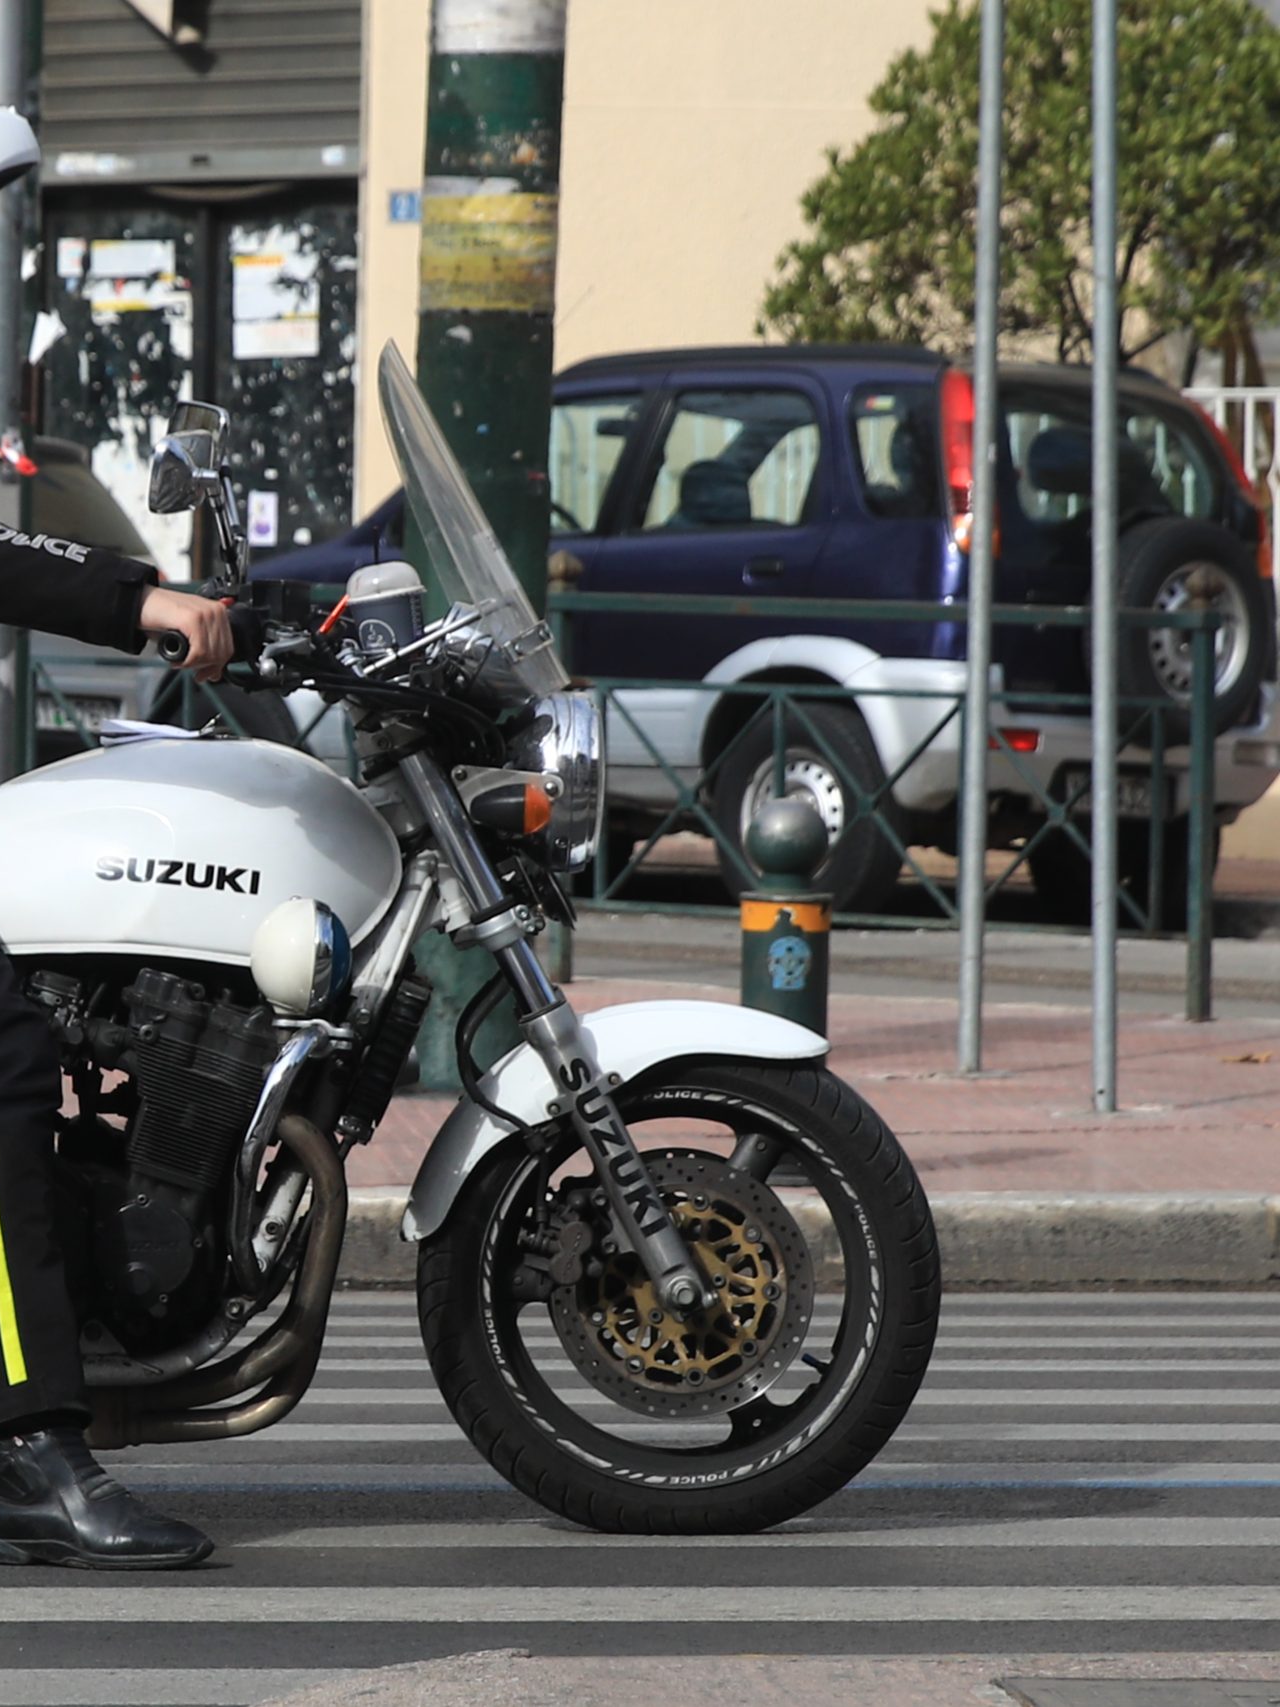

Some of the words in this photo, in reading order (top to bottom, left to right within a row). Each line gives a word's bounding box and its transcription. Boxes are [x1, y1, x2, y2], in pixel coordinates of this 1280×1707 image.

[95, 855, 261, 896] SUZUKI
[559, 1058, 669, 1239] SUZUKI
[853, 1204, 878, 1260] POLICE
[484, 1309, 506, 1364] POLICE
[669, 1470, 728, 1485] POLICE
